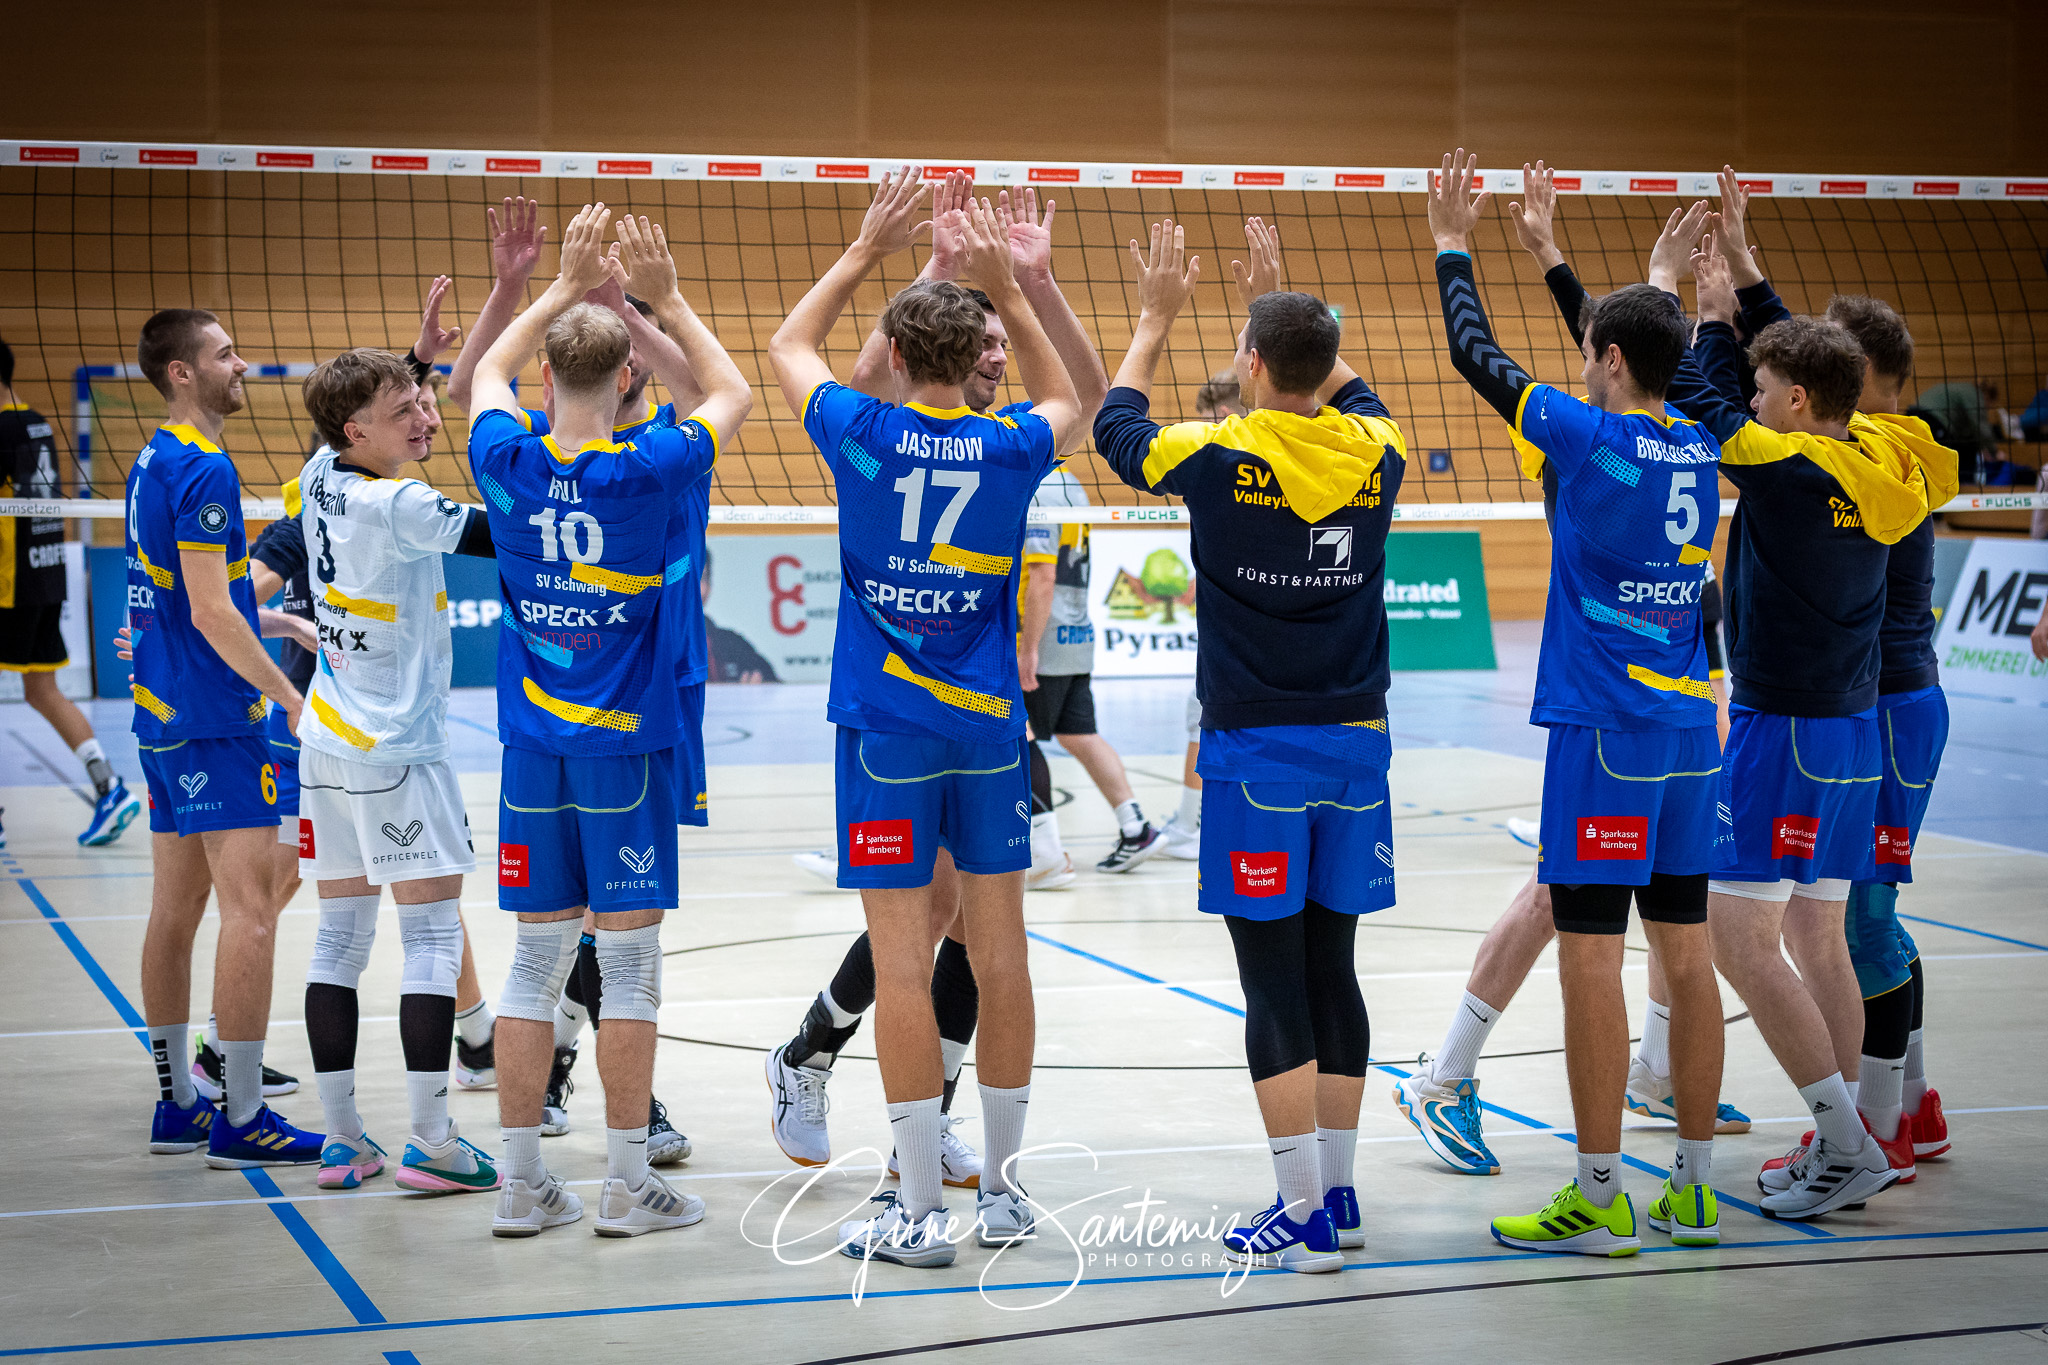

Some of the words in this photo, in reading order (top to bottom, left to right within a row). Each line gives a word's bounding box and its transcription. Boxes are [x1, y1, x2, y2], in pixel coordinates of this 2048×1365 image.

[896, 429, 983, 461] JASTROW
[1236, 463, 1272, 488] SV
[893, 466, 980, 544] 17
[1127, 510, 1179, 520] FUCHS
[1665, 471, 1700, 546] 5
[1986, 498, 2032, 508] FUCHS
[528, 507, 604, 565] 10
[315, 516, 336, 584] 3
[888, 555, 905, 571] SV
[908, 559, 966, 579] Schwaig
[536, 573, 550, 588] SV
[554, 575, 607, 597] Schwaig
[863, 579, 955, 614] SPECK
[1618, 580, 1697, 605] SPECK
[520, 599, 598, 627] SPECK
[260, 763, 277, 806] 6
[866, 834, 903, 845] Sparkasse
[1600, 830, 1639, 839] Sparkasse
[1600, 841, 1637, 851] Nürnberg
[372, 850, 439, 865] OFFICEWELT
